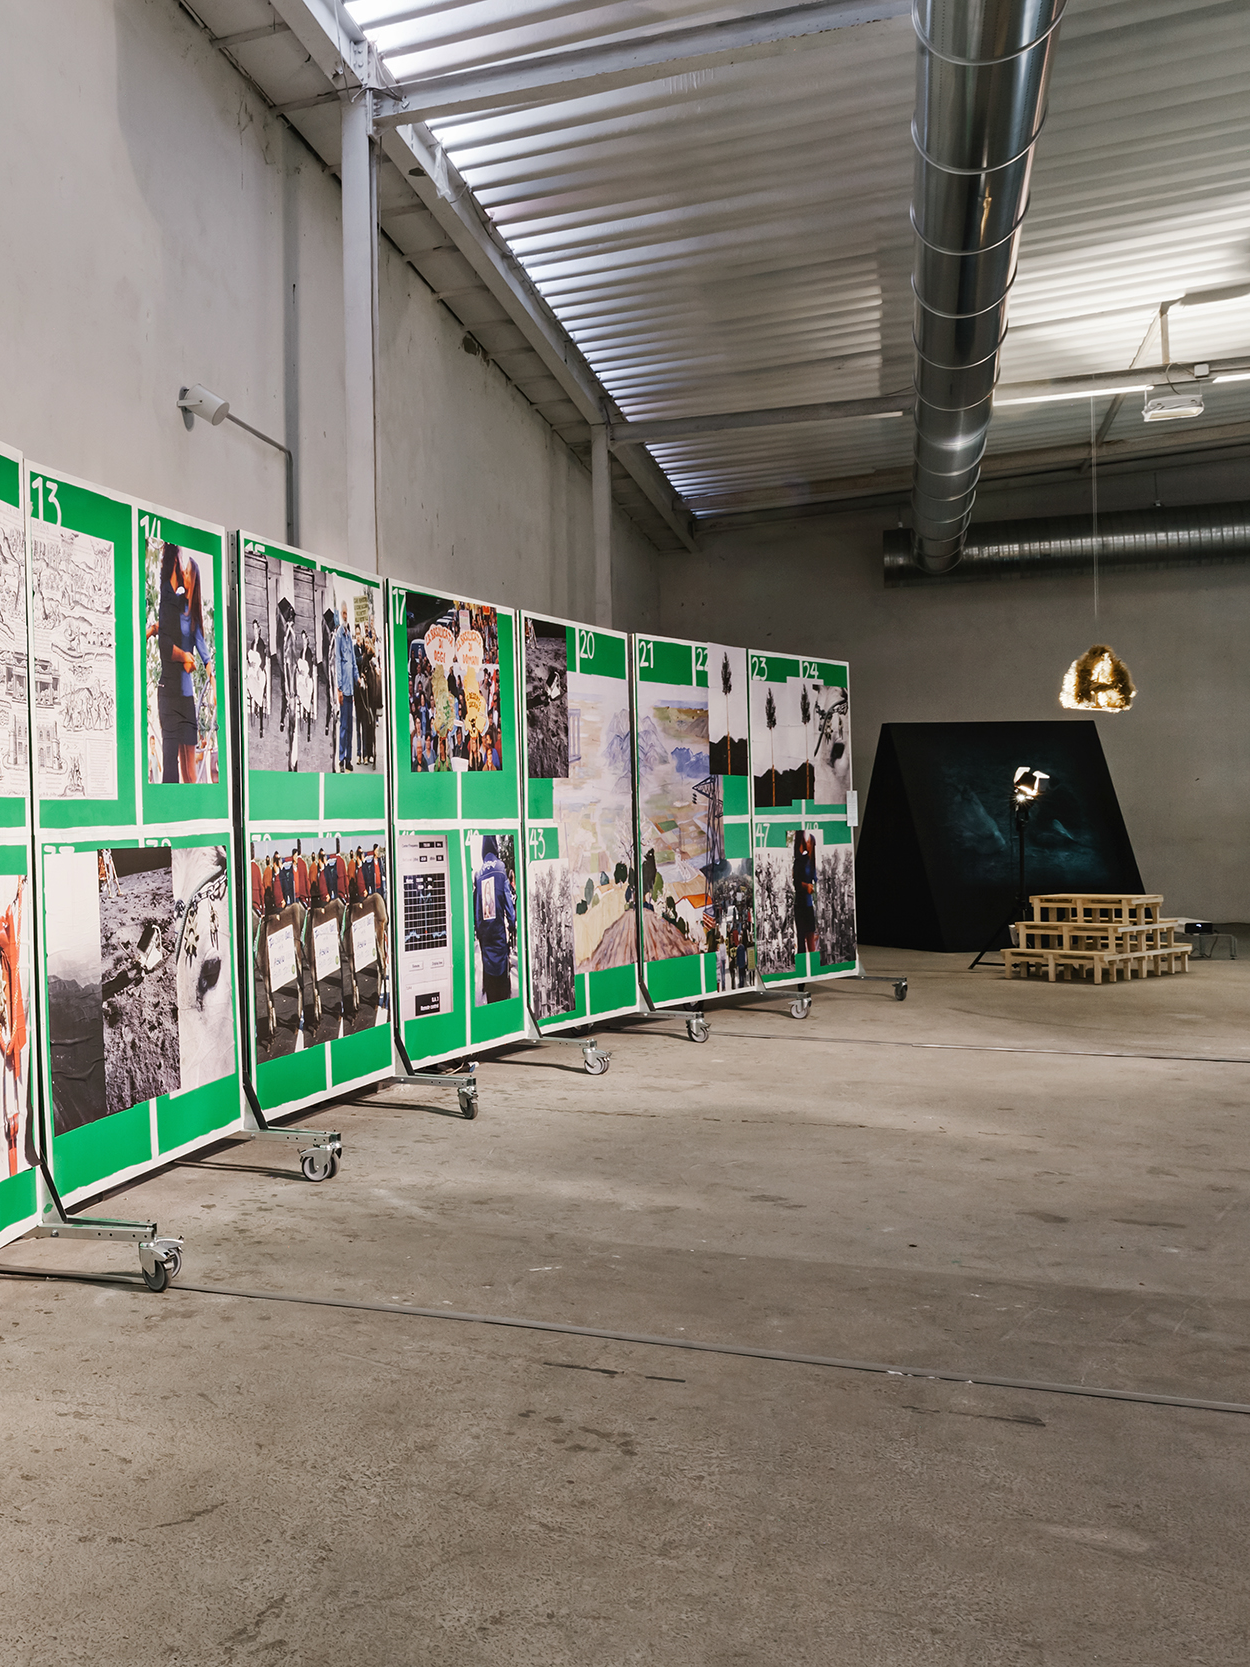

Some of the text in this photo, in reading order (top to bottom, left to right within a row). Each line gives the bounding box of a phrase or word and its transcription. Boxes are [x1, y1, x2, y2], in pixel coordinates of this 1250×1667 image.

[31, 476, 62, 527] 13
[392, 588, 407, 625] 17
[580, 630, 595, 659] 20
[639, 641, 654, 668] 21
[752, 656, 768, 681] 23
[529, 828, 546, 860] 43
[756, 823, 770, 848] 47
